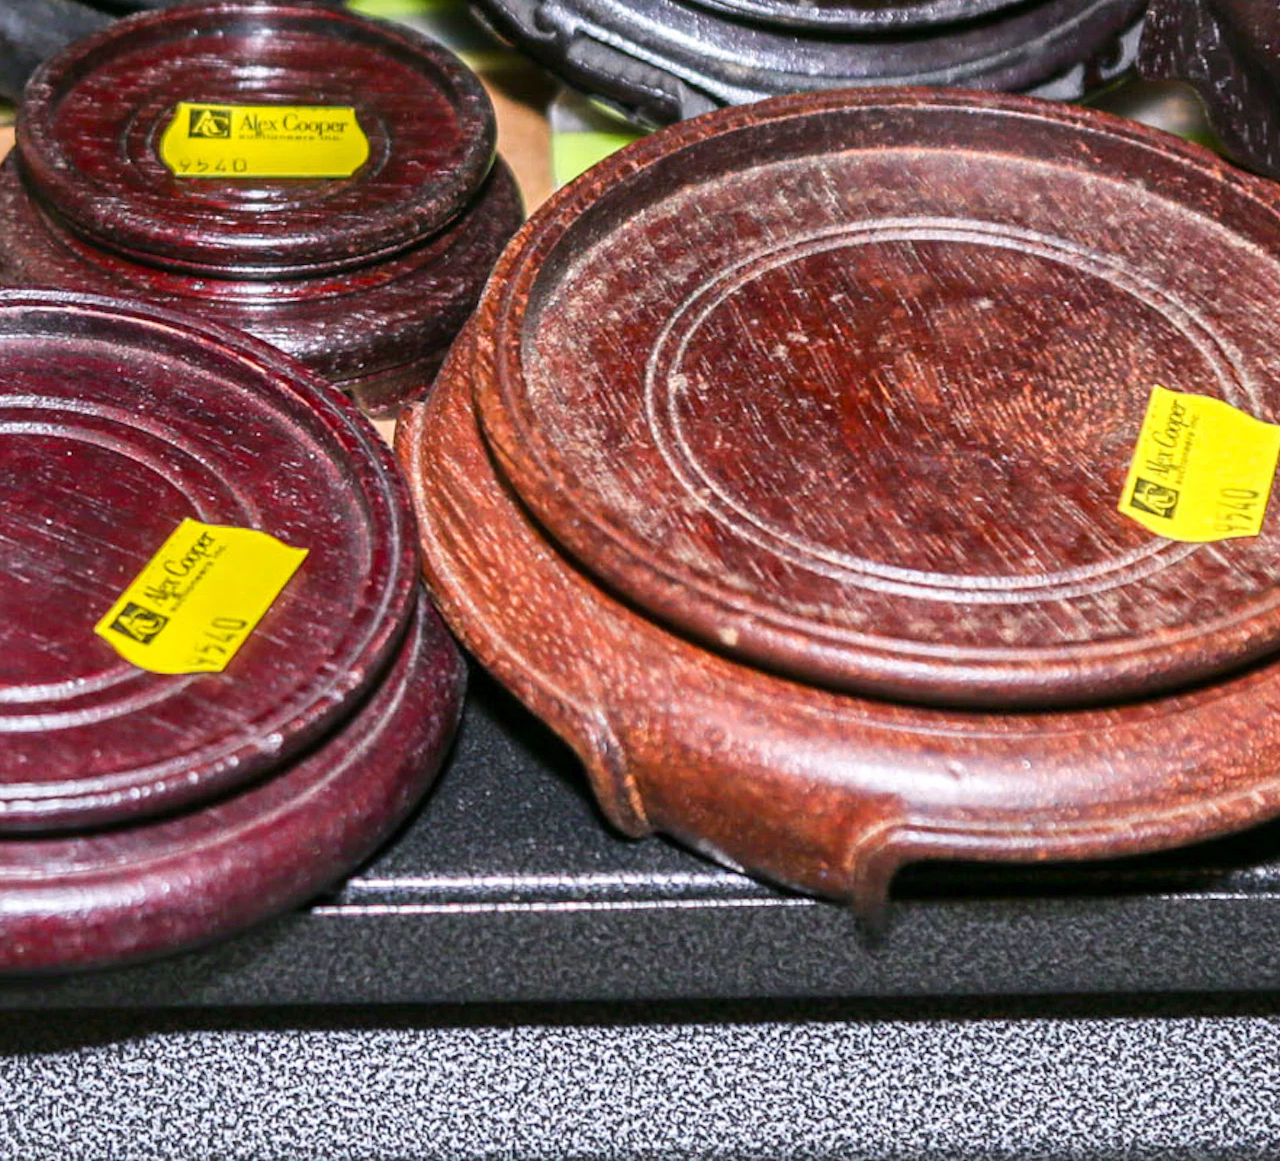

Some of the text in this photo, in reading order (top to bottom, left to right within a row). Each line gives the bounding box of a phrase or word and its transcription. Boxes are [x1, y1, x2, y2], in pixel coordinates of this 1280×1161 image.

[239, 113, 349, 136] Alex Cooper
[1152, 399, 1190, 448] Cooper
[1146, 450, 1177, 481] Alex
[143, 576, 178, 607] Alex
[163, 531, 216, 577] Cooper
